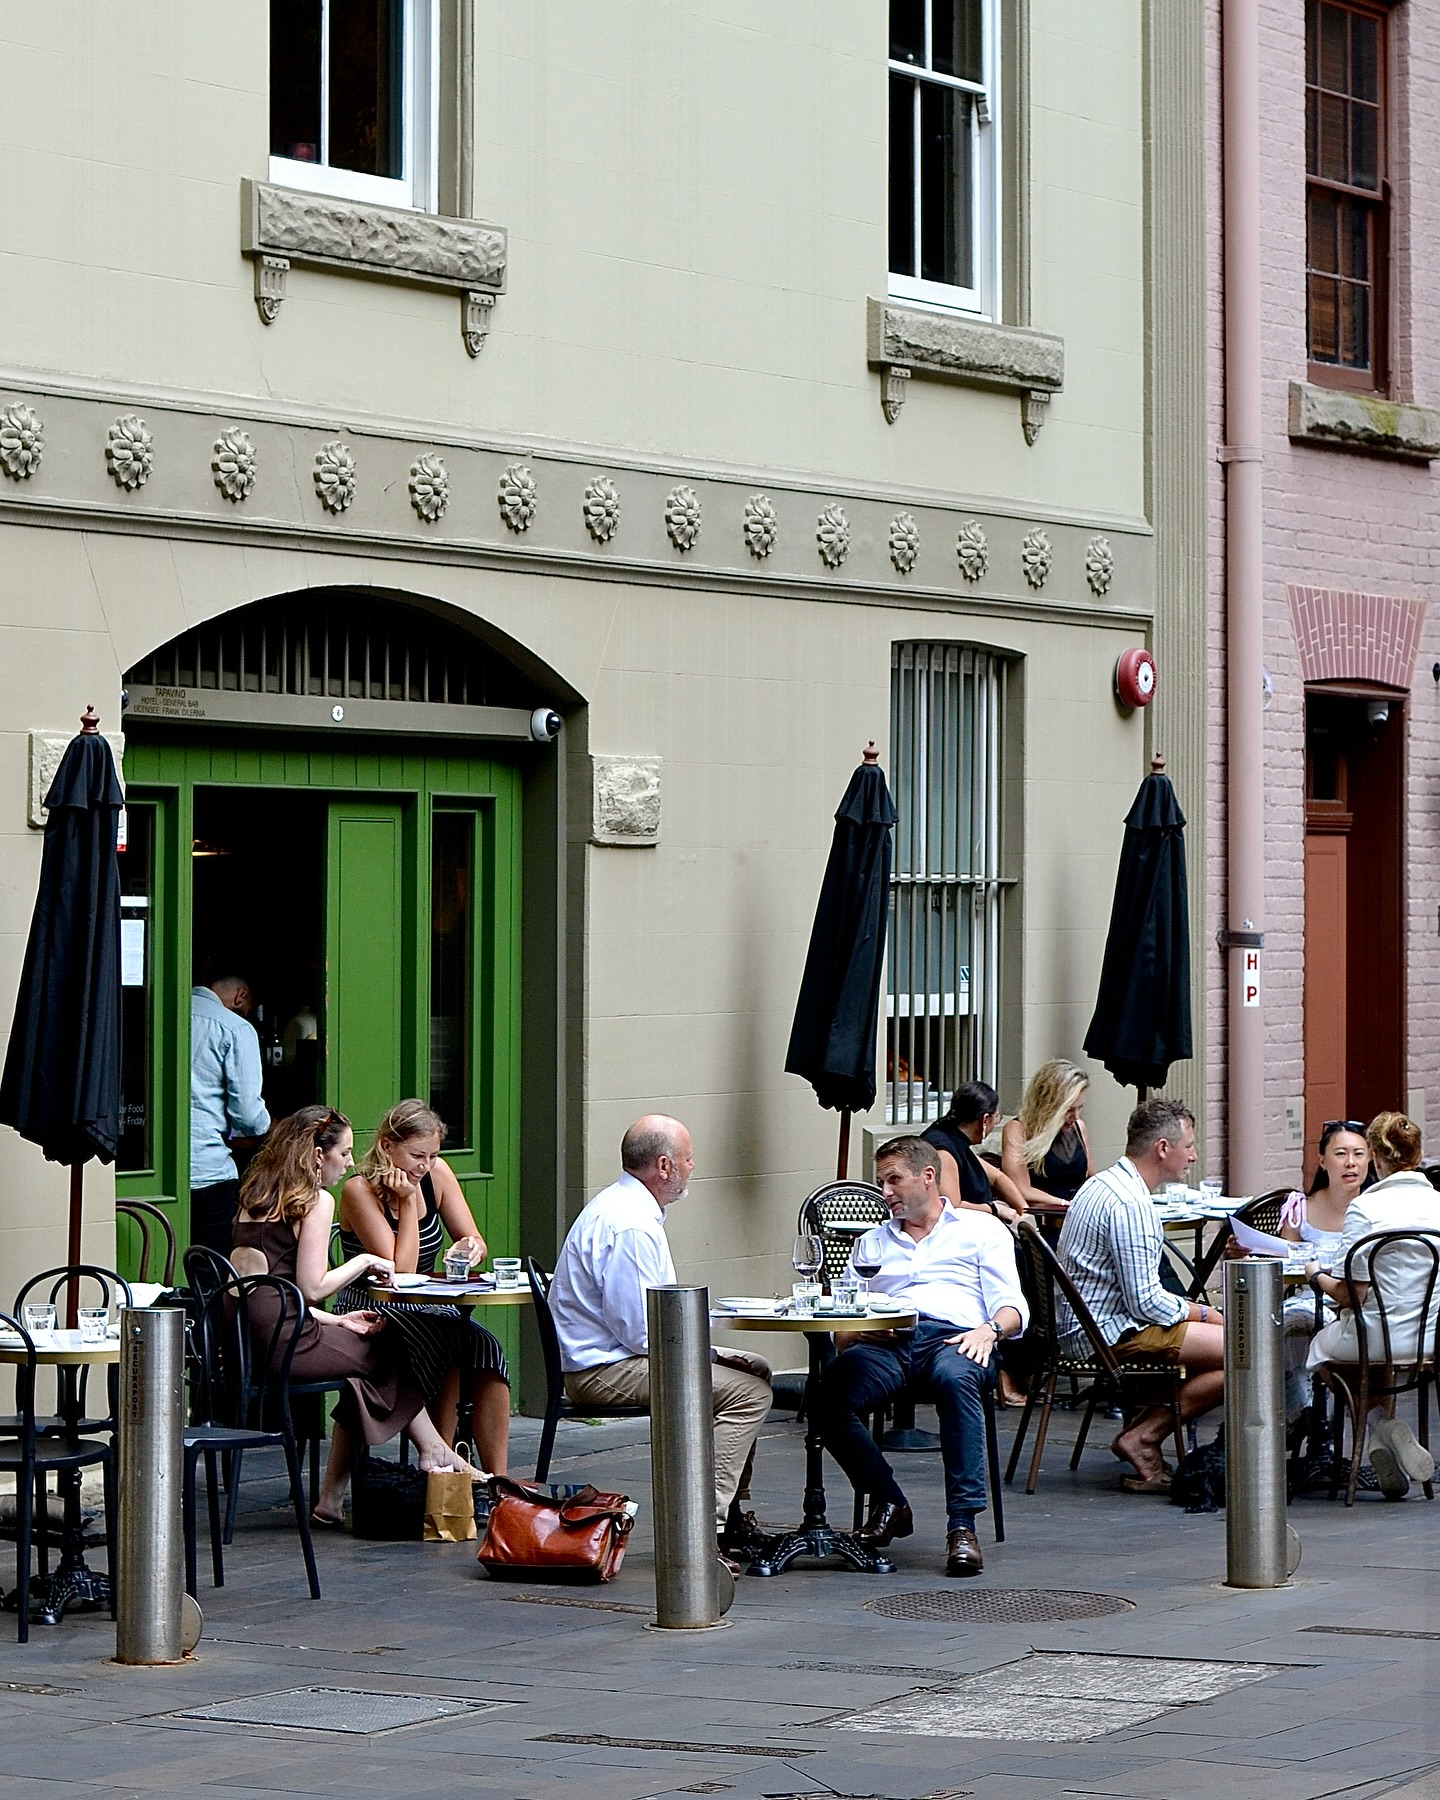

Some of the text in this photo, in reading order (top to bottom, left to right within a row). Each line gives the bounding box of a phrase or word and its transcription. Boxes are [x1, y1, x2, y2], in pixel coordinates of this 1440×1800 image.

[155, 687, 186, 698] TAPAVINO
[141, 697, 159, 705] HOTEL
[162, 699, 187, 707] GENERAL
[188, 700, 199, 708] BAR
[128, 1104, 144, 1113] Food
[127, 1116, 146, 1127] Friday
